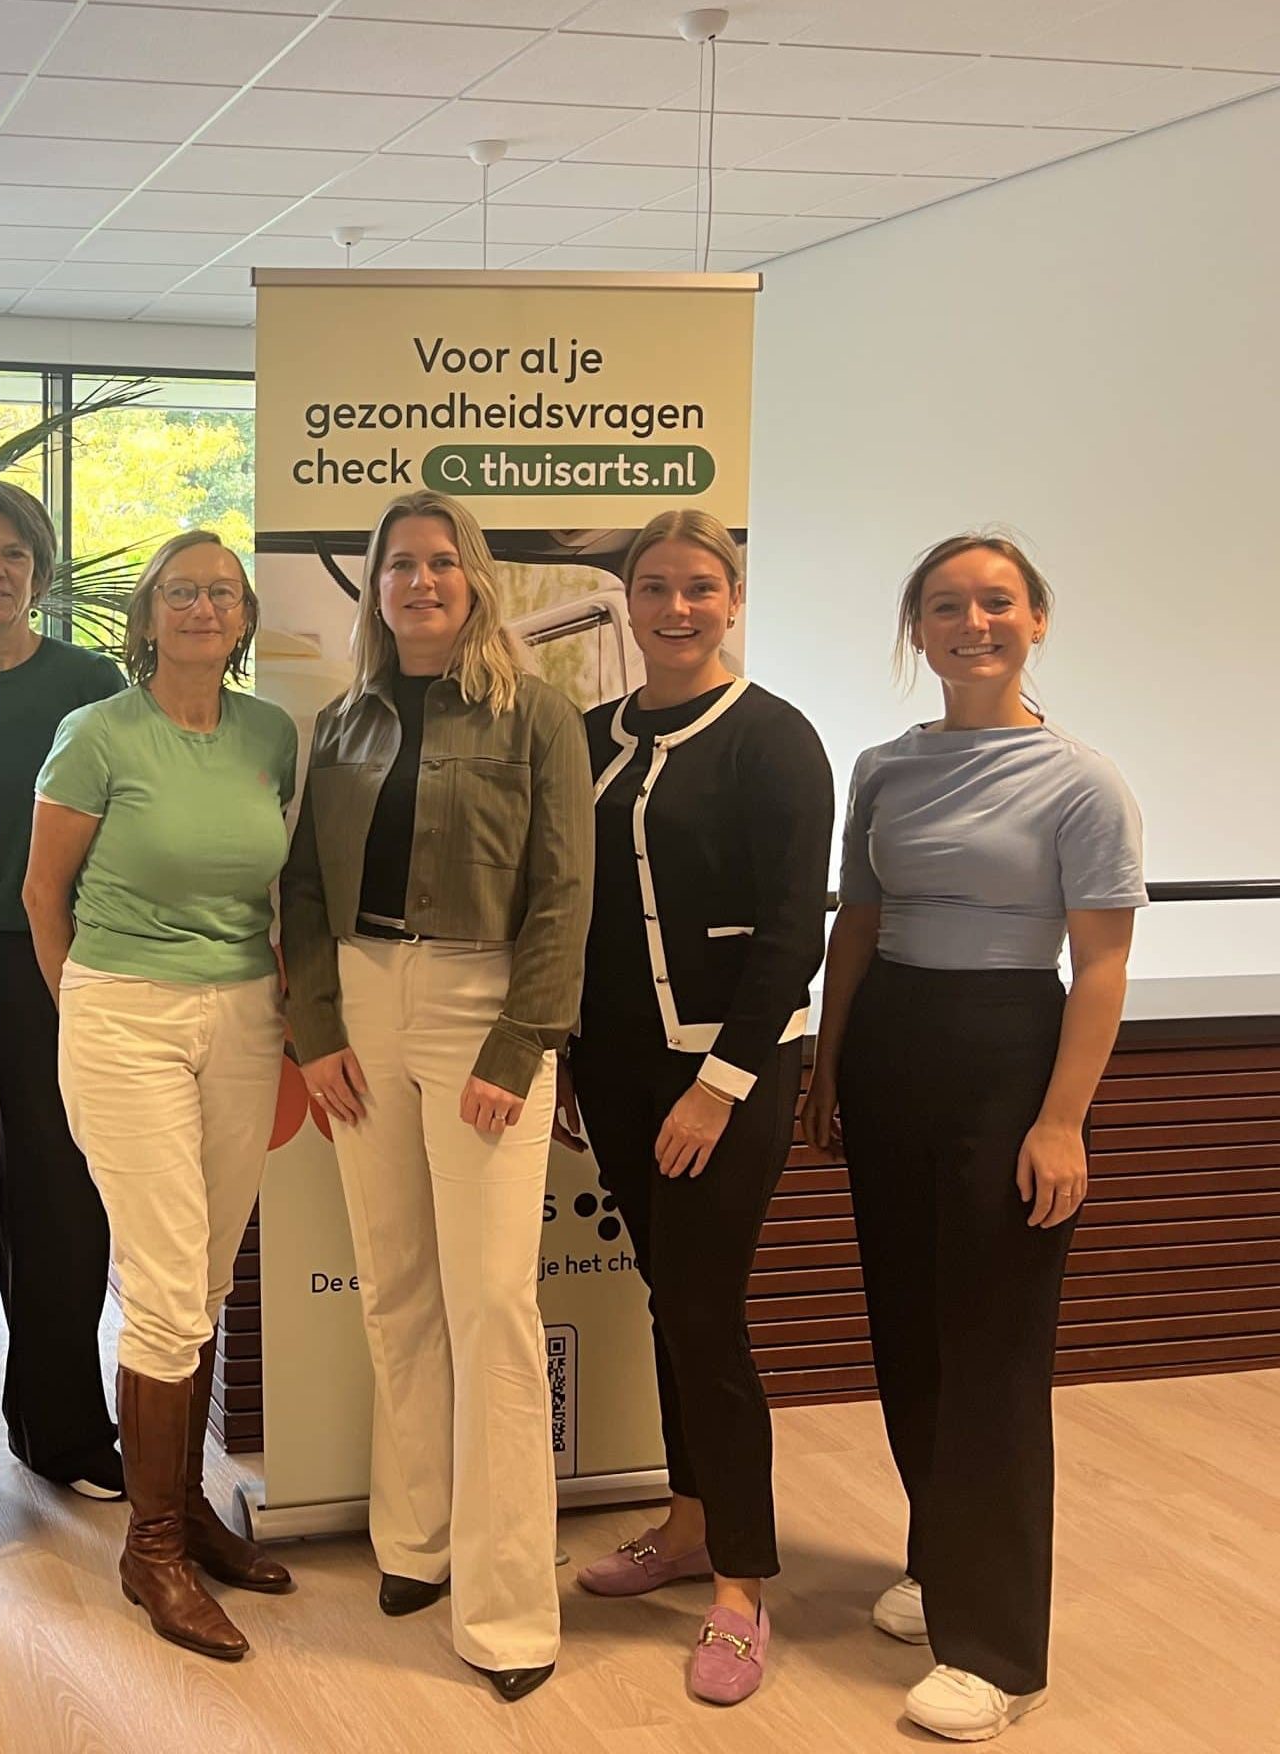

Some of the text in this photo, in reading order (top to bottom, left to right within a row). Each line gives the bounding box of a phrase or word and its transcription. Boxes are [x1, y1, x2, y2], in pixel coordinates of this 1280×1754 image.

[414, 337, 604, 384] Voor al je
[305, 392, 705, 439] gezondheidsvragen
[292, 448, 697, 487] check thuisarts.nl
[311, 1273, 343, 1293] De
[537, 1257, 560, 1282] je
[565, 1253, 602, 1275] het
